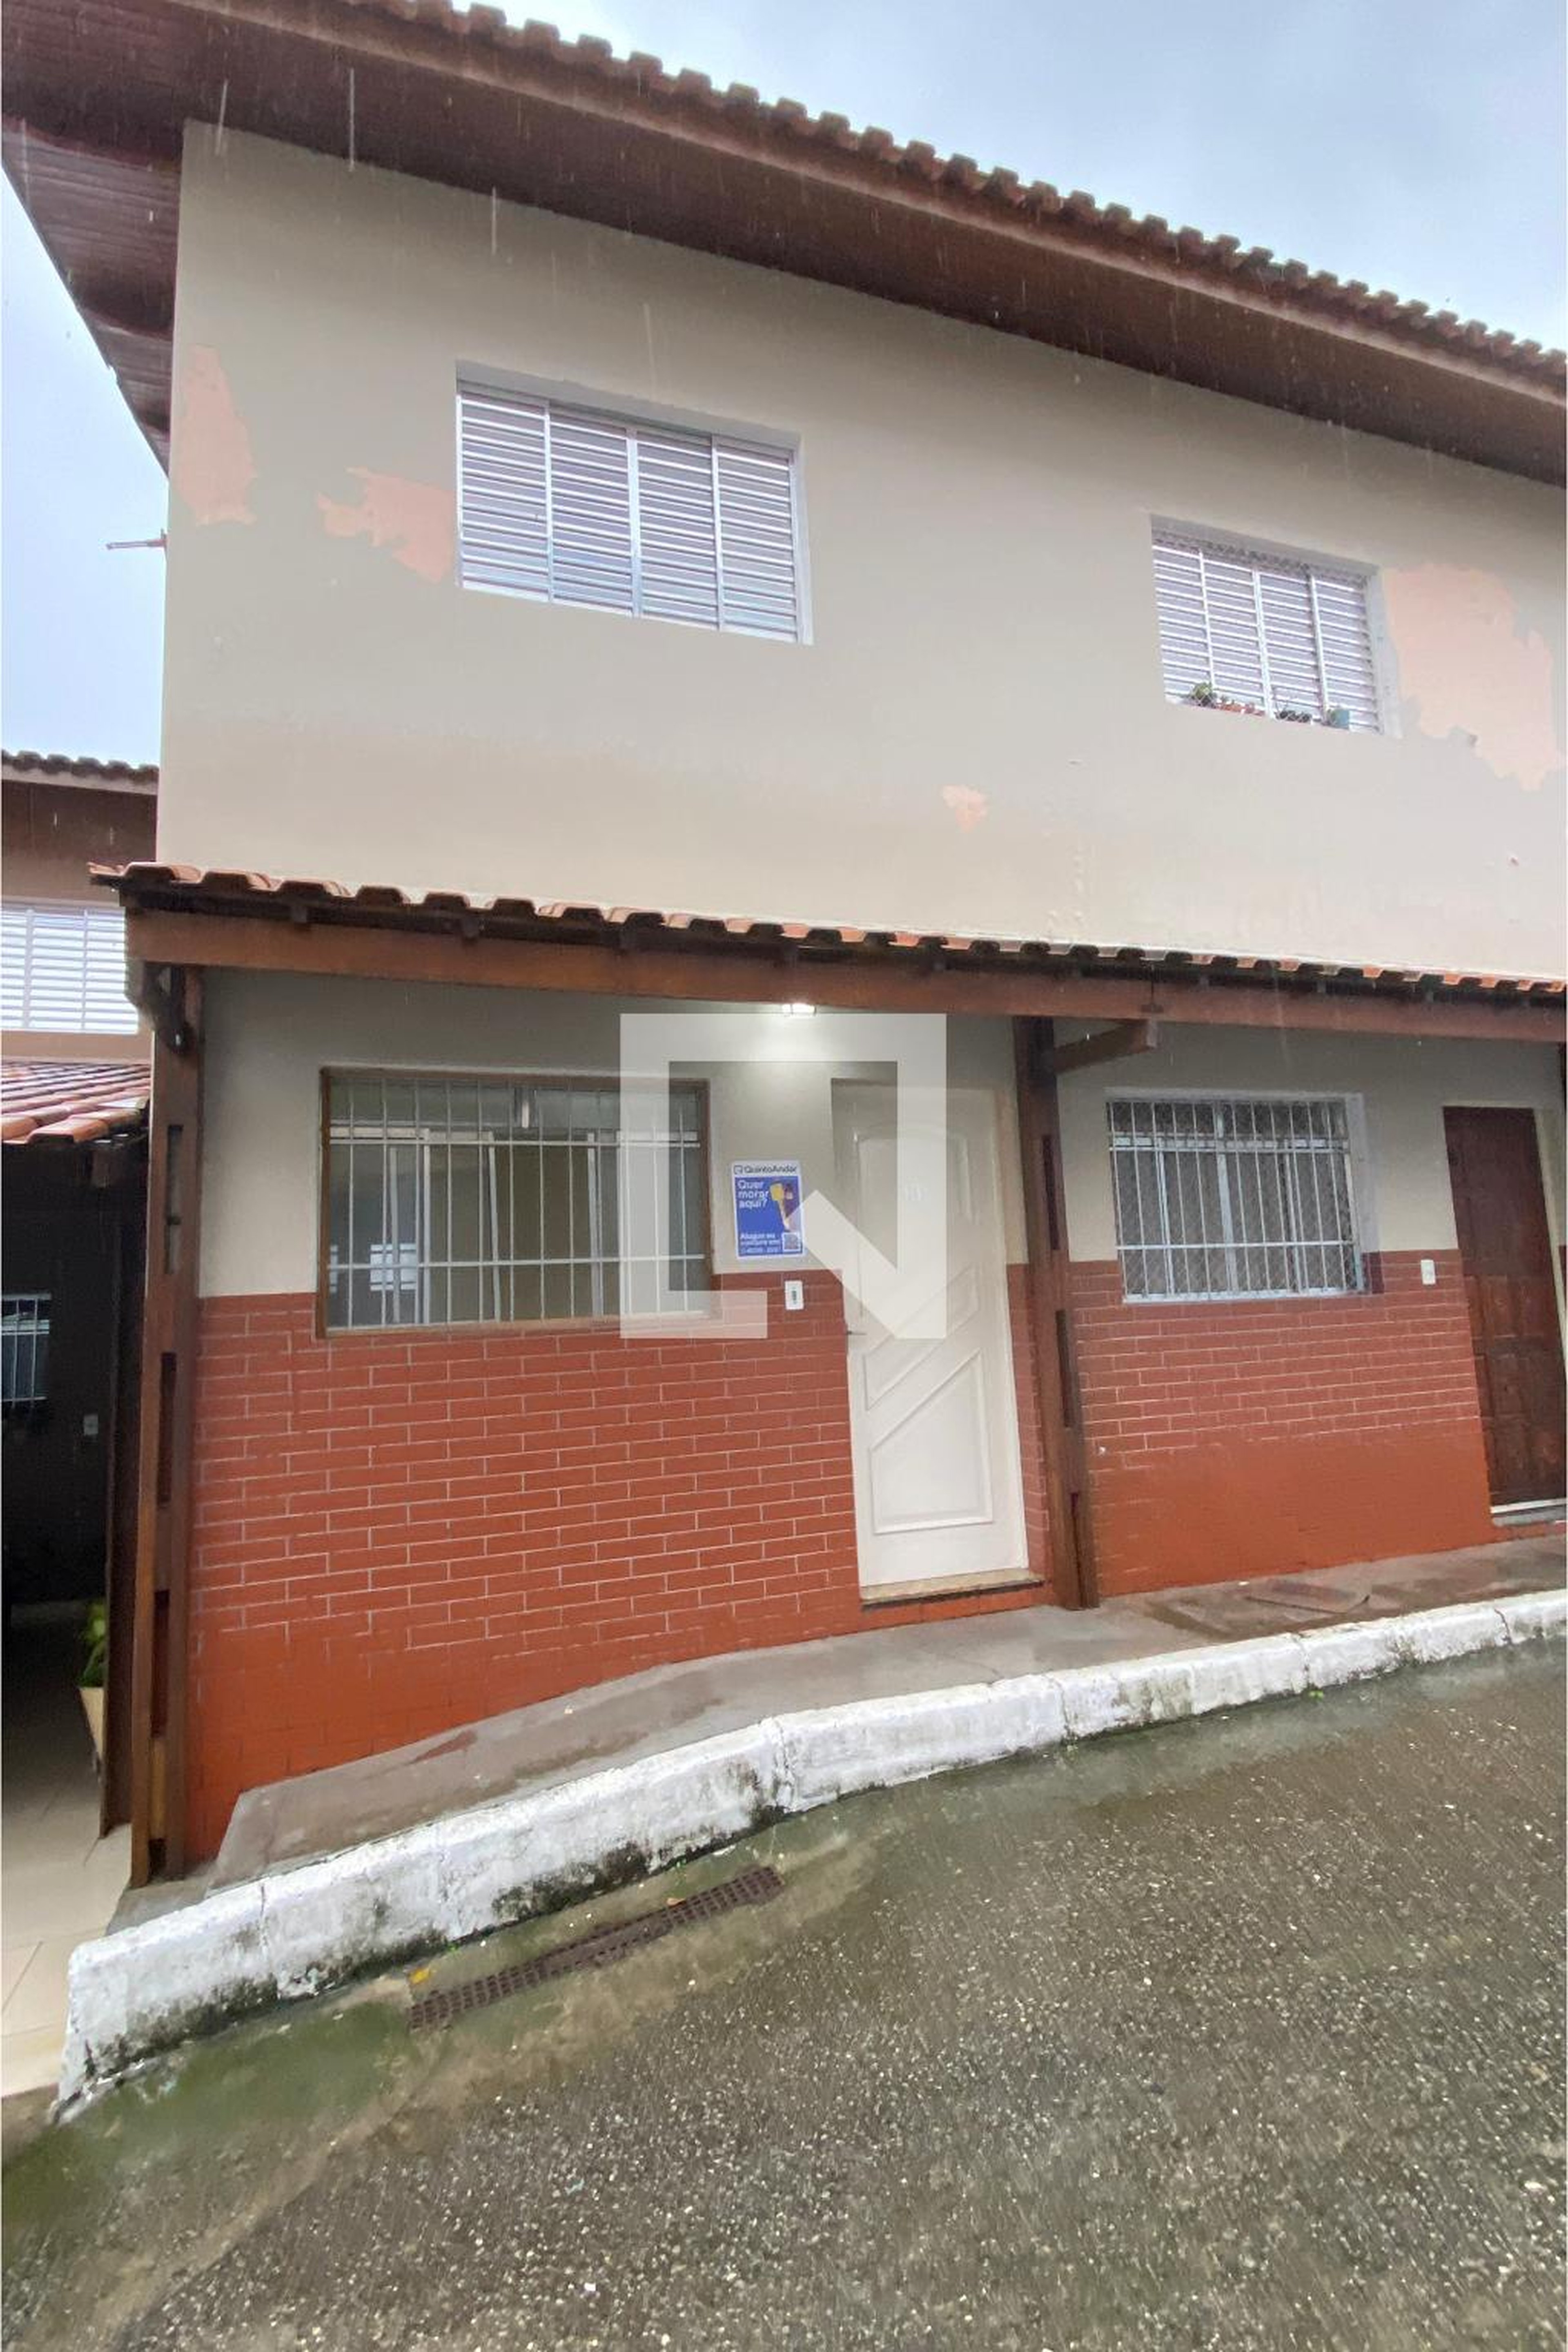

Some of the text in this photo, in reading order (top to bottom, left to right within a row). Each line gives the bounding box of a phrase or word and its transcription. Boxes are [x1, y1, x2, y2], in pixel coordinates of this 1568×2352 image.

[737, 1180, 764, 1189] Quer
[738, 1190, 768, 1198] morar
[739, 1198, 768, 1209] aqui?
